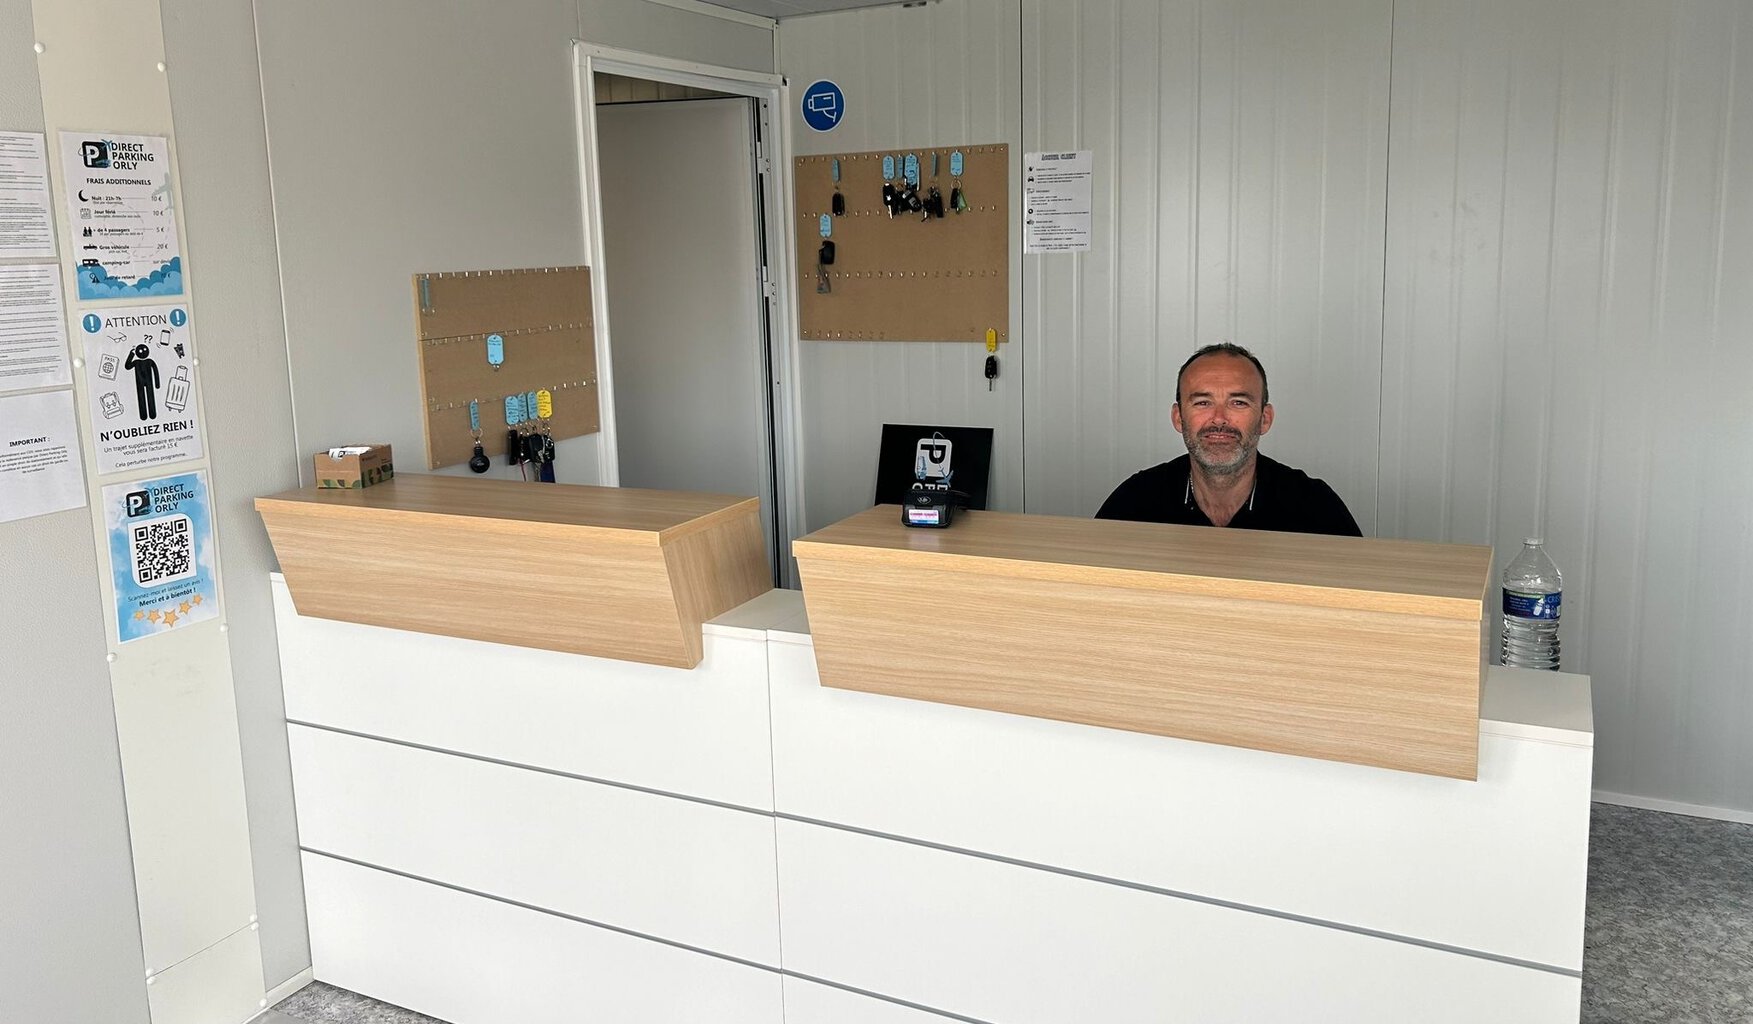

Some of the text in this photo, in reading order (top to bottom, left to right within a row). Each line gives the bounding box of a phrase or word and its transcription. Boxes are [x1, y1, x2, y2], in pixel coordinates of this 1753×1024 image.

[111, 143, 143, 152] DIRECT
[112, 152, 154, 162] PARKING
[113, 161, 138, 170] ORLY
[105, 314, 167, 328] ATTENTION
[100, 424, 161, 442] N'OUBLIEZ
[163, 420, 188, 433] RIEN
[9, 436, 47, 447] IMPORTANT
[113, 445, 127, 454] trajet
[128, 439, 168, 452] supplémentaire
[175, 435, 193, 443] navette
[149, 444, 166, 452] facturé
[126, 456, 147, 467] perturbe
[147, 455, 160, 463] notre
[153, 484, 184, 496] DIRECT
[154, 491, 194, 505] PARKING
[155, 502, 179, 513] ORLY
[128, 590, 161, 602] Scannez-moi
[139, 597, 157, 607] Merci
[170, 589, 192, 599] bientôt
